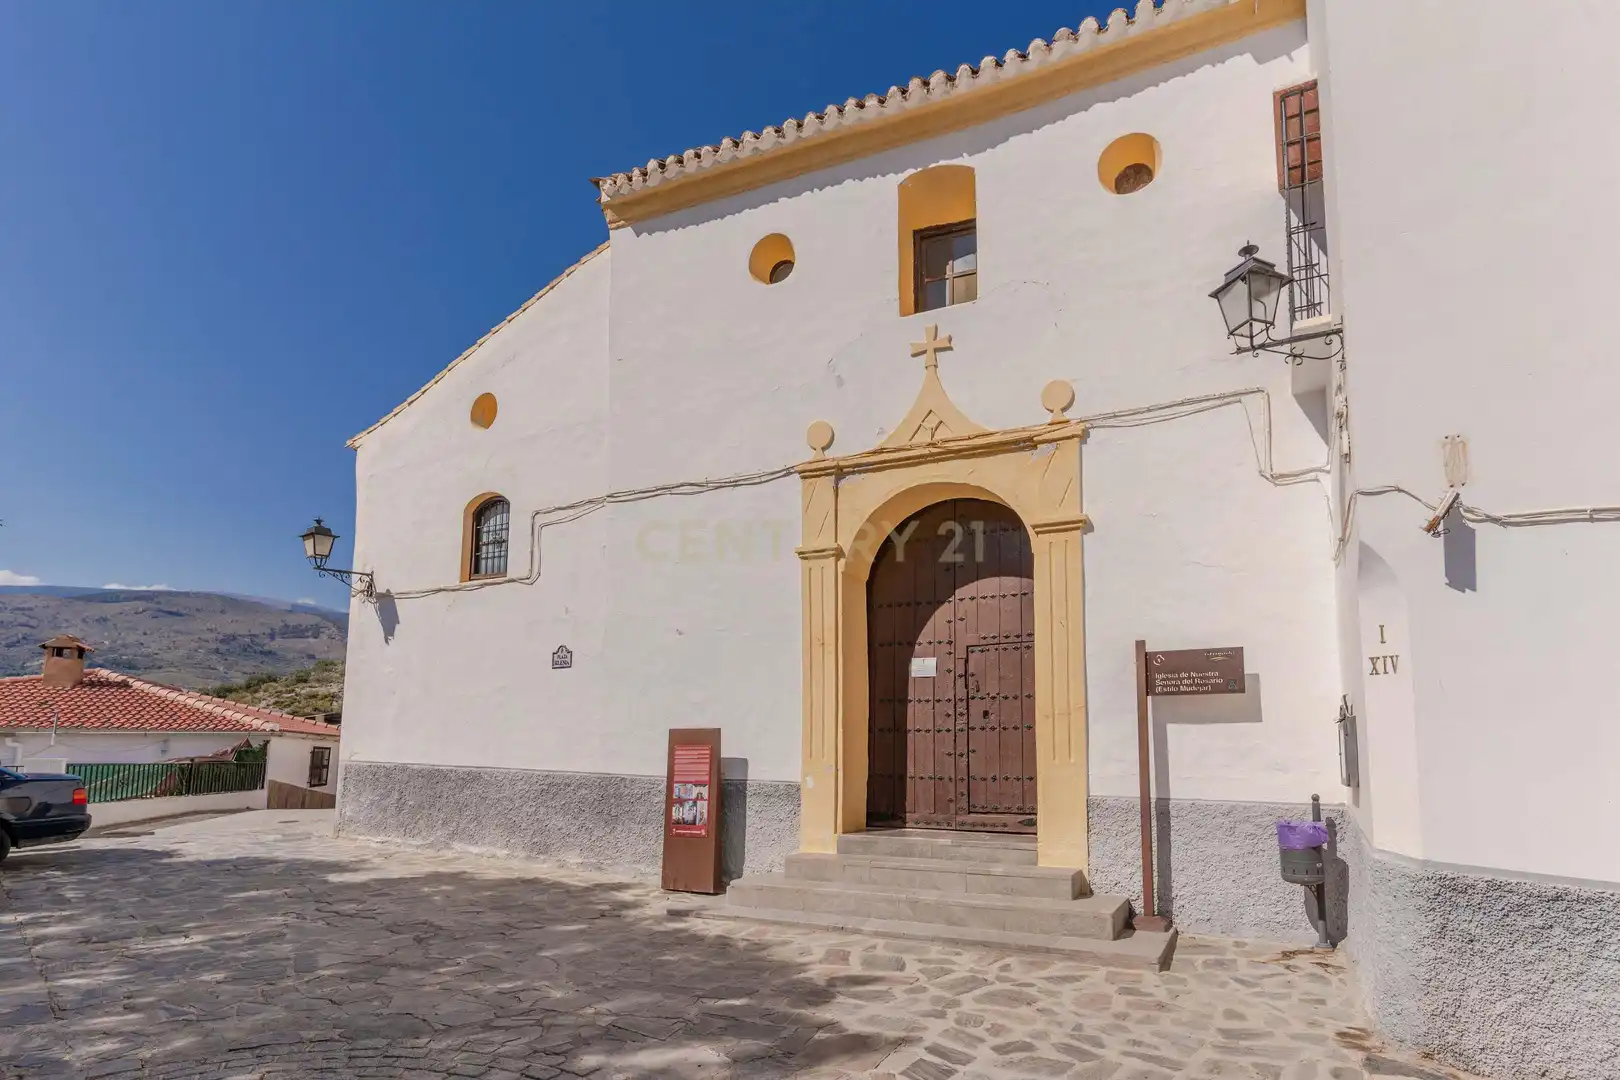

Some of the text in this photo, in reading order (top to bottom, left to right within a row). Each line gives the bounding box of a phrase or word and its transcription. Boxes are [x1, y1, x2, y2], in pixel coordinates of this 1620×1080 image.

[1368, 654, 1399, 675] XIV
[1155, 671, 1178, 680] Iglesia
[1155, 685, 1178, 693] (Estilo
